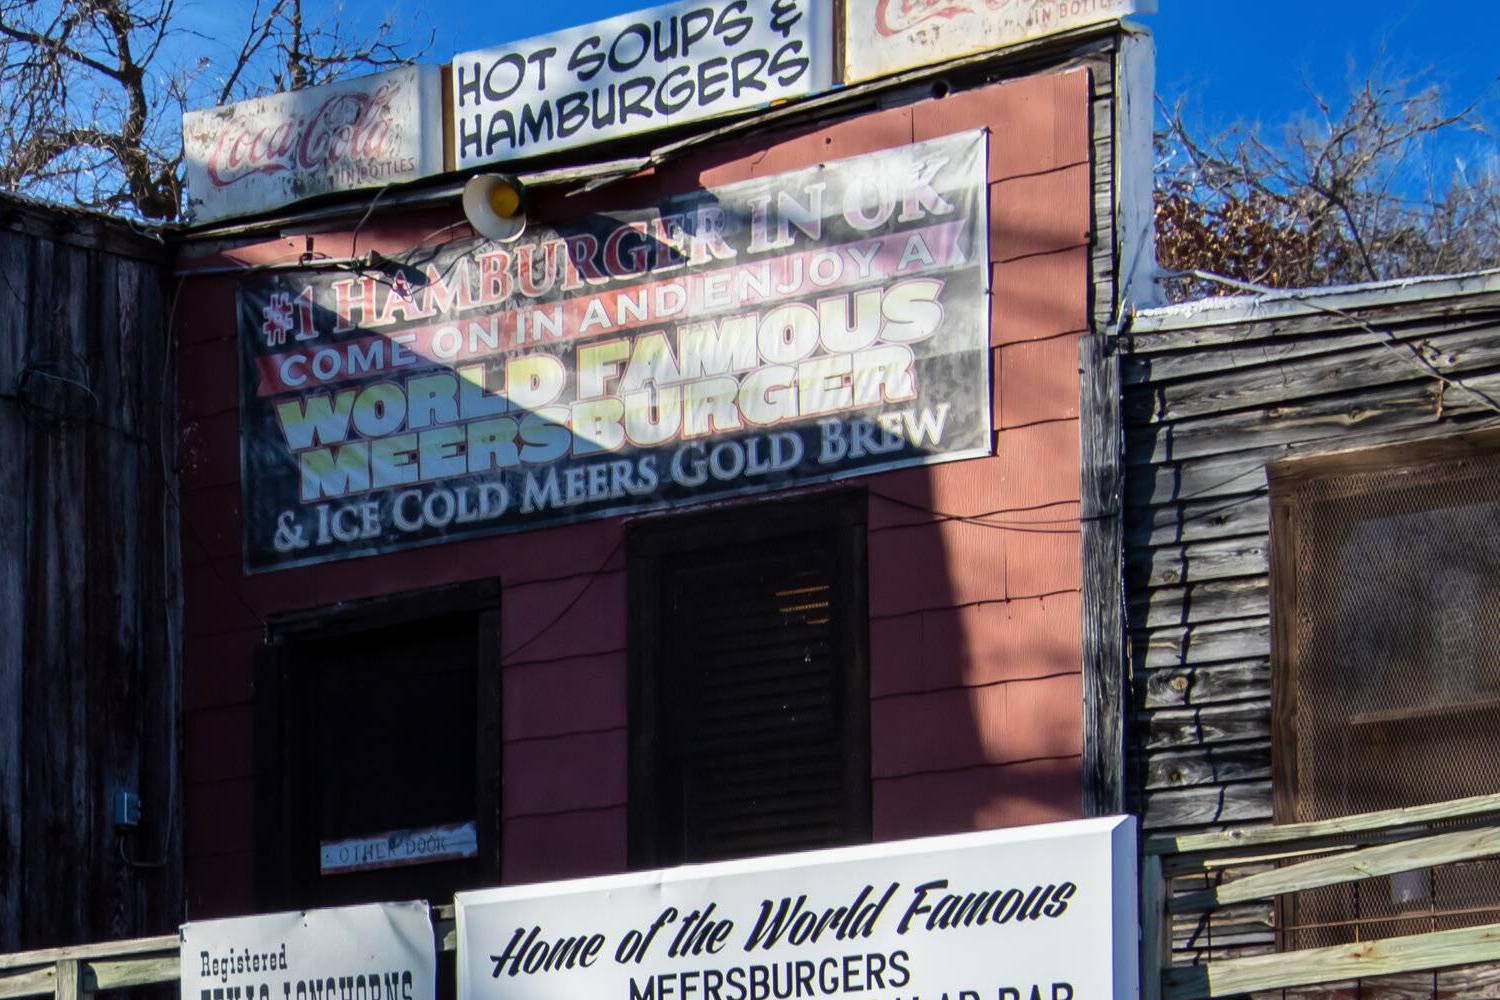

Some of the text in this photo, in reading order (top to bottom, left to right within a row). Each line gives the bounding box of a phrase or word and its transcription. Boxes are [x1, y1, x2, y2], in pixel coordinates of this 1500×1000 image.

[458, 46, 556, 107] HOT
[567, 0, 754, 82] SOUPS
[769, 0, 803, 38] &
[459, 39, 810, 158] HAMBURGERS
[262, 156, 955, 347] #1 HAMBURGER IN OK
[279, 234, 935, 387] COME ON IN AND ENJOY A
[274, 278, 946, 453] WORLD FAMOUS
[300, 342, 918, 503] MEERSBURGER
[273, 402, 952, 553] & ICE COLD MEERS GOLD BREW
[201, 944, 288, 983] Registered
[490, 879, 1077, 978] Home of the World Famous
